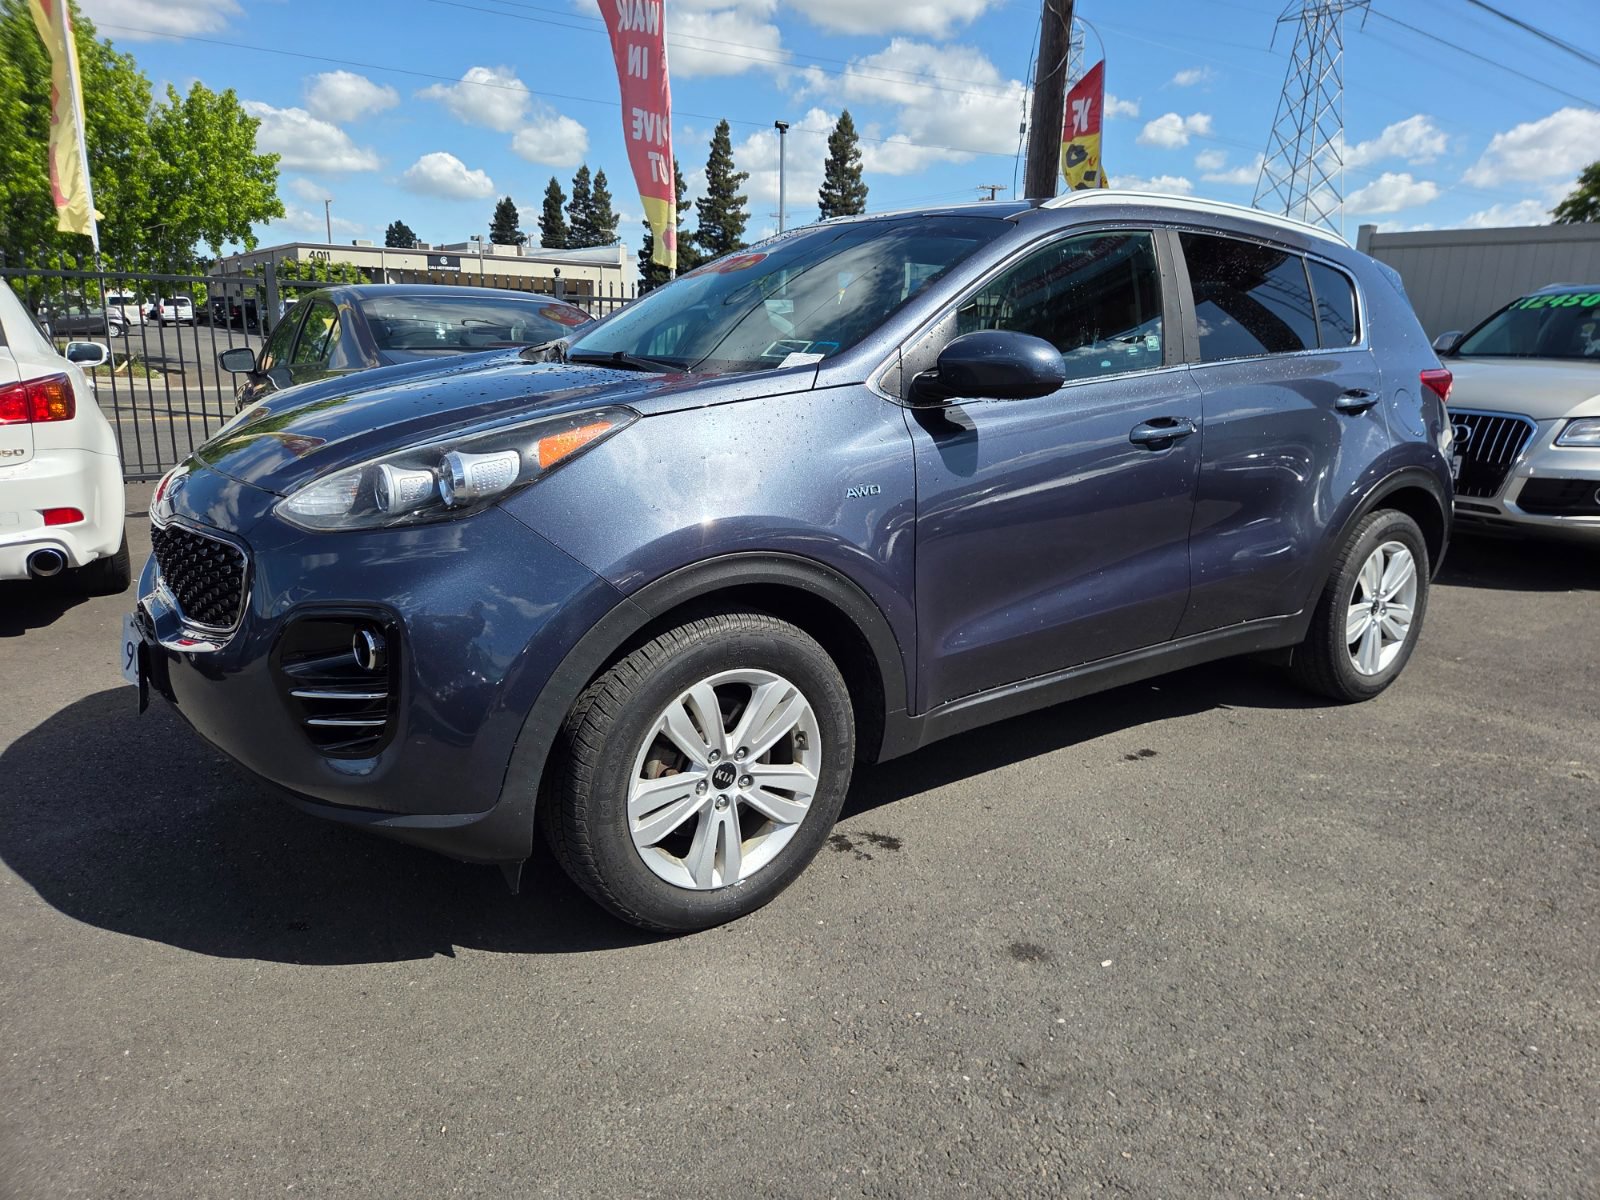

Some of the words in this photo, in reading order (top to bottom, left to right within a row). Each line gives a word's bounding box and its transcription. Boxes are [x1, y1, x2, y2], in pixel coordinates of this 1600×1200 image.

[308, 250, 331, 262] 4011
[0, 448, 25, 458] 50
[846, 483, 881, 499] AWD
[715, 769, 734, 784] KIA
